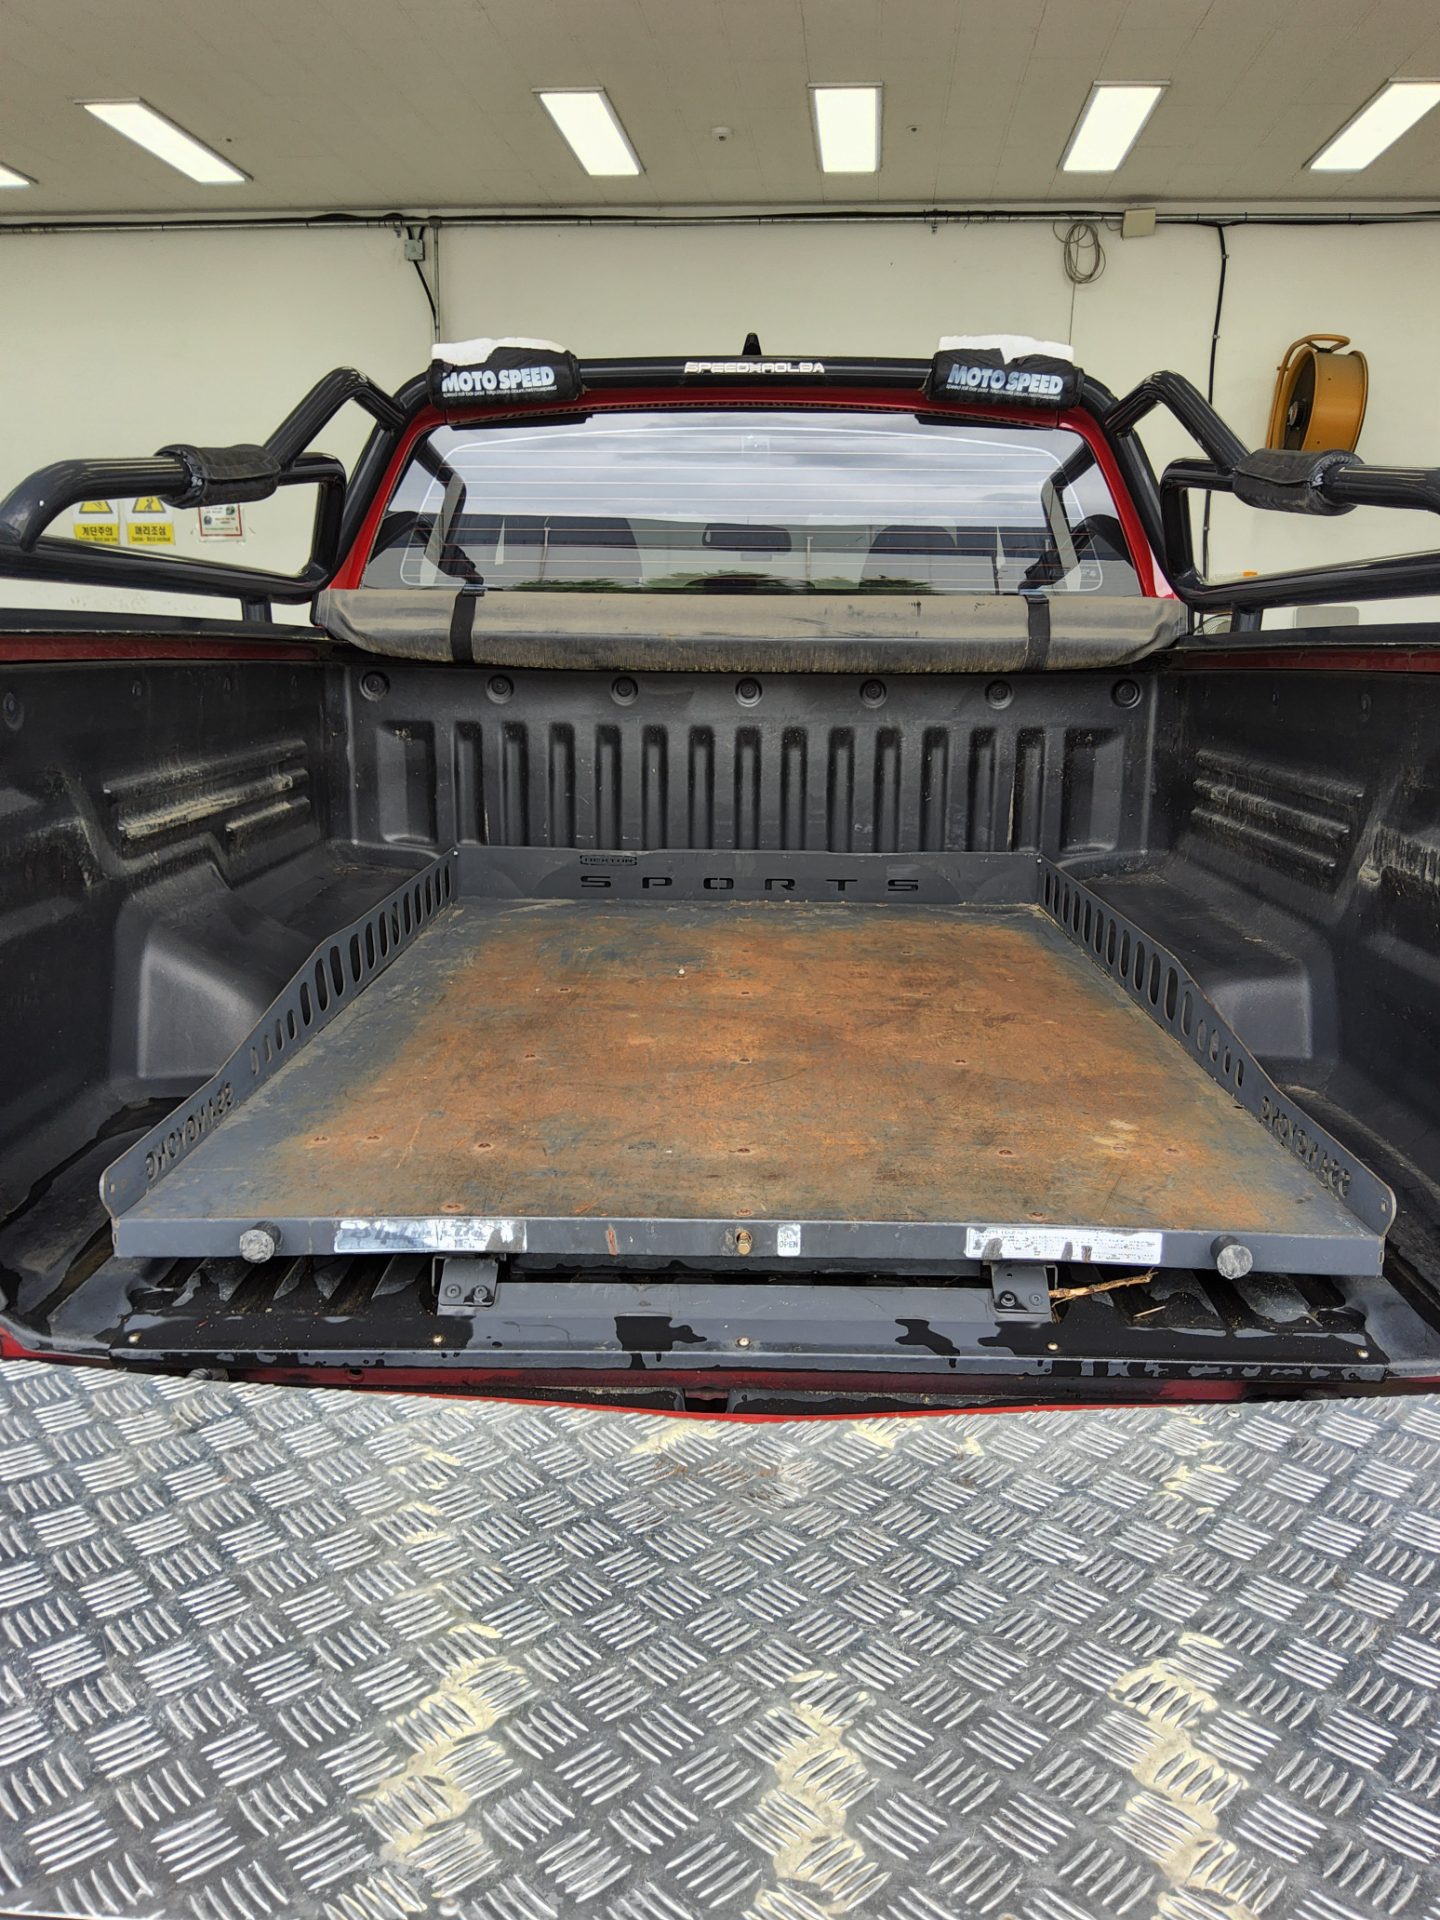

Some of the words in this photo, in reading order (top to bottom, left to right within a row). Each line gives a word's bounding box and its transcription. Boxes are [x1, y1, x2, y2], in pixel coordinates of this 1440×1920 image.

[441, 370, 498, 393] MOTO
[498, 366, 555, 389] SPEED
[947, 363, 1006, 390] MOTO
[1005, 371, 1064, 395] SPEED
[81, 526, 113, 537] 계단주의
[580, 875, 919, 892] SPORTS
